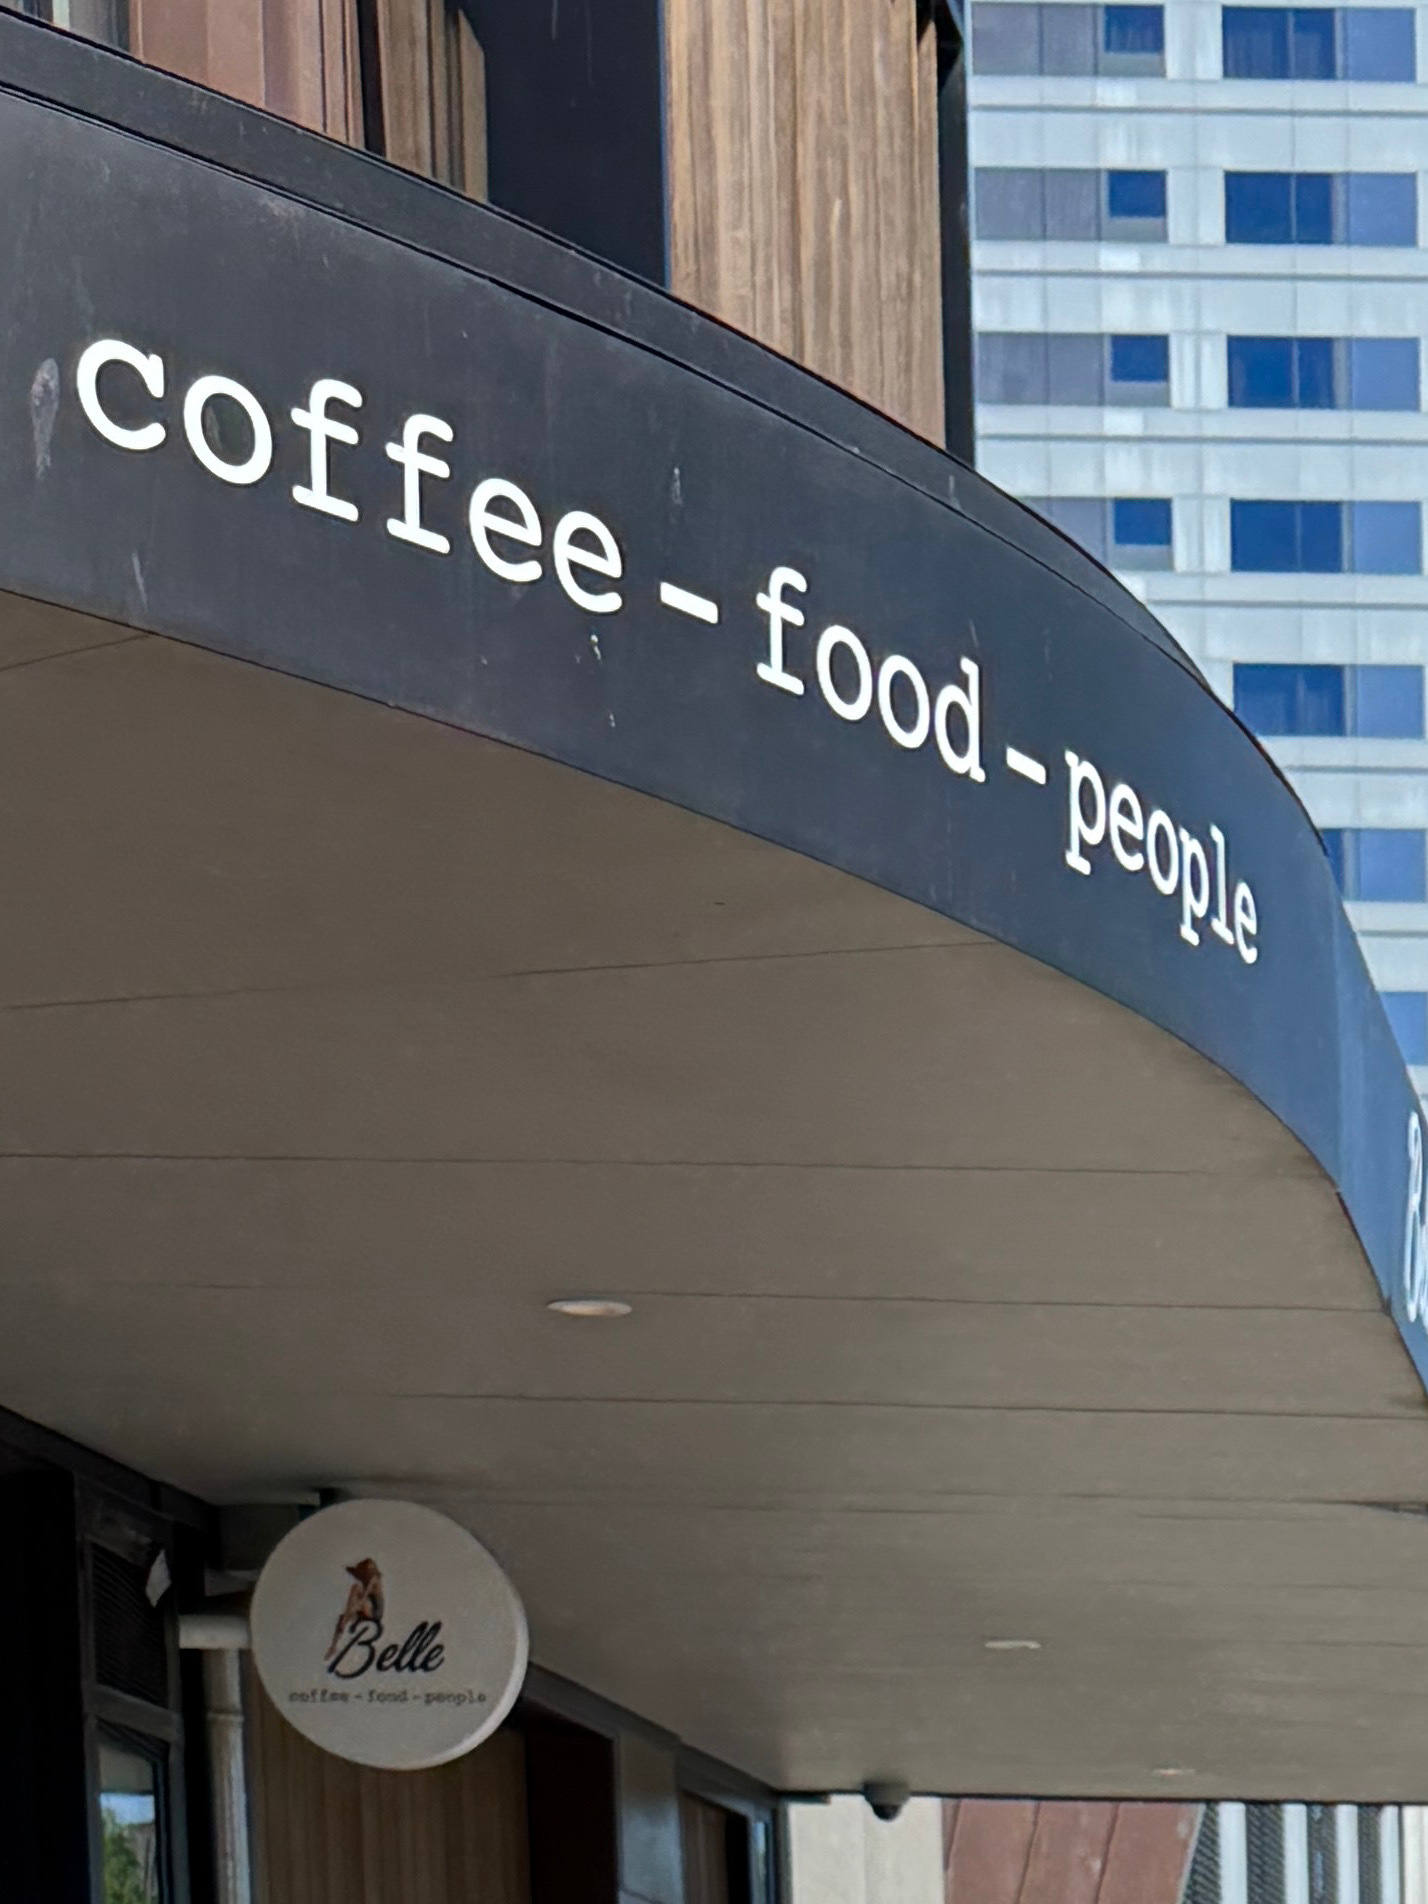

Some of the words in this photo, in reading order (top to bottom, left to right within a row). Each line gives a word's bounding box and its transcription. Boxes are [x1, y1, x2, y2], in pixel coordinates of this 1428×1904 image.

[75, 338, 623, 614] coffee
[755, 565, 987, 785] food
[1064, 749, 1259, 965] people
[327, 1618, 445, 1680] Belle
